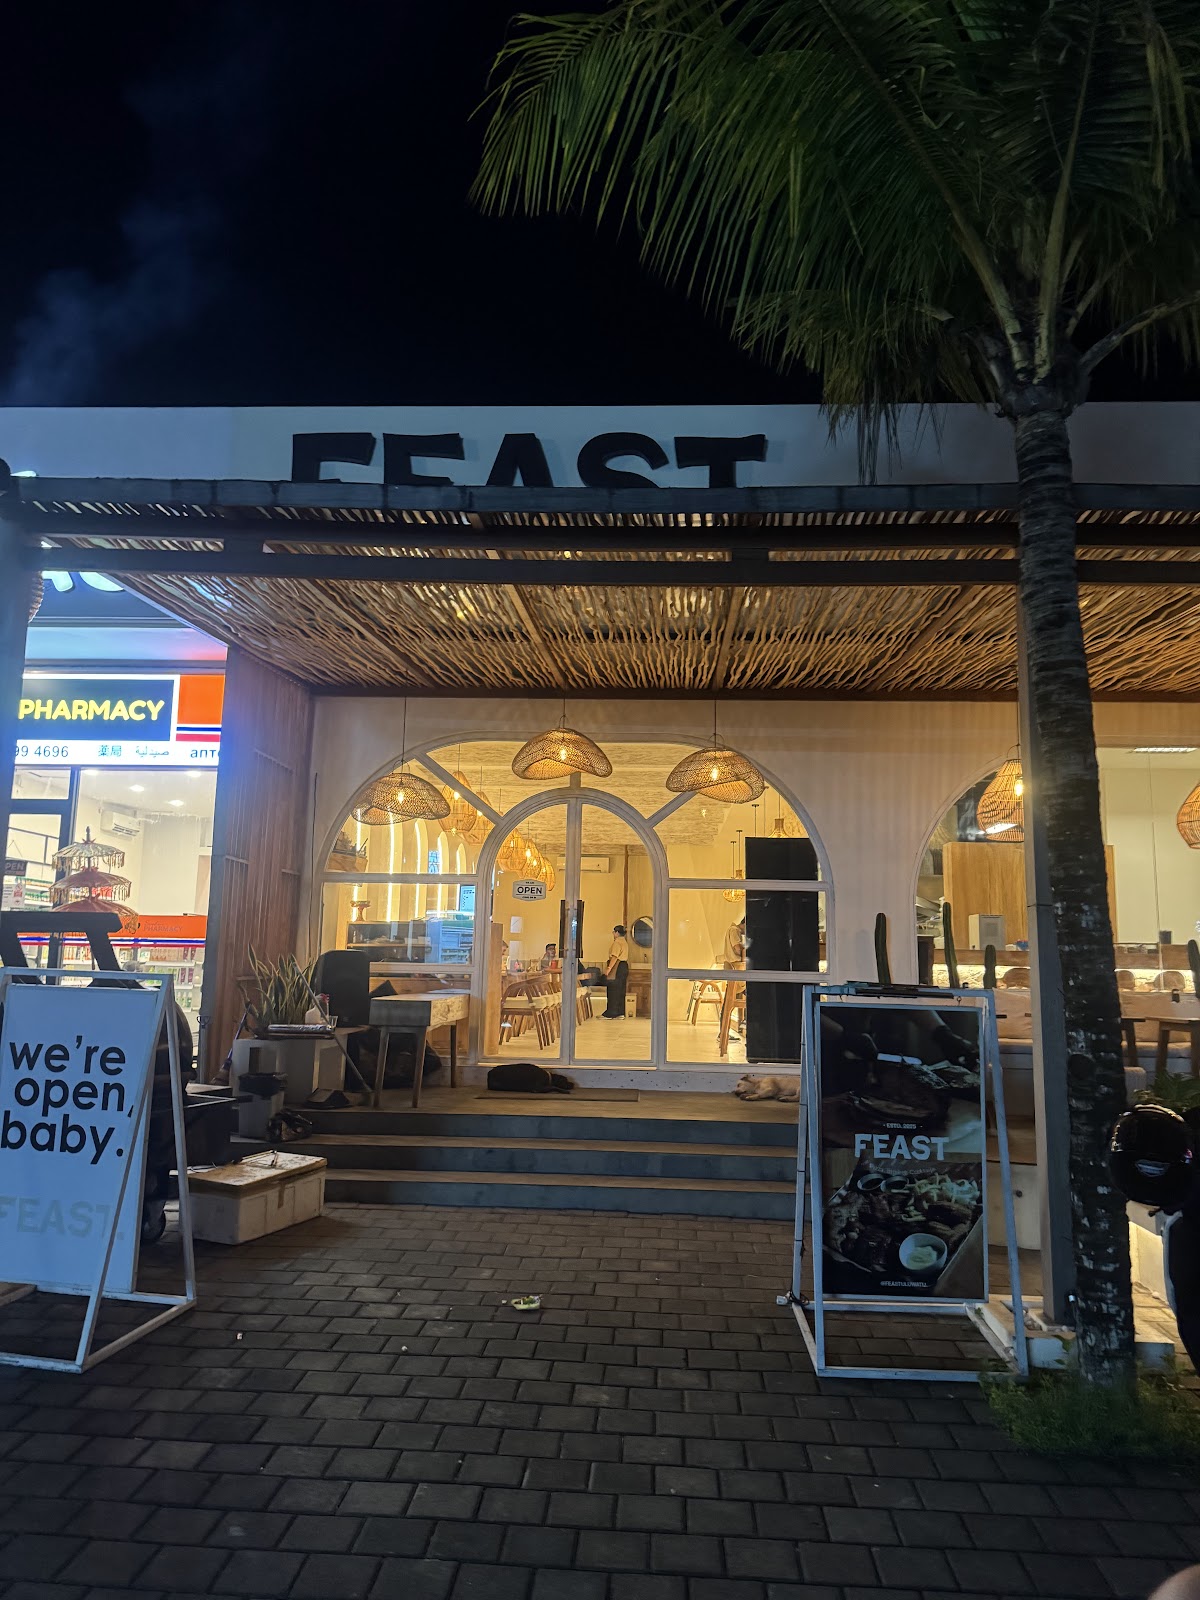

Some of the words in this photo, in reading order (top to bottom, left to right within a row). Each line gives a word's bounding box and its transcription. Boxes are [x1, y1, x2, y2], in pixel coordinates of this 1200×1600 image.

[18, 699, 165, 721] PHARMACY
[34, 745, 69, 758] 4696
[135, 745, 170, 758] صيدلية
[517, 886, 542, 894] OPEN
[9, 1035, 126, 1076] we're
[14, 1077, 134, 1118] open,
[0, 1110, 124, 1165] baby.
[854, 1133, 950, 1161] FEAST
